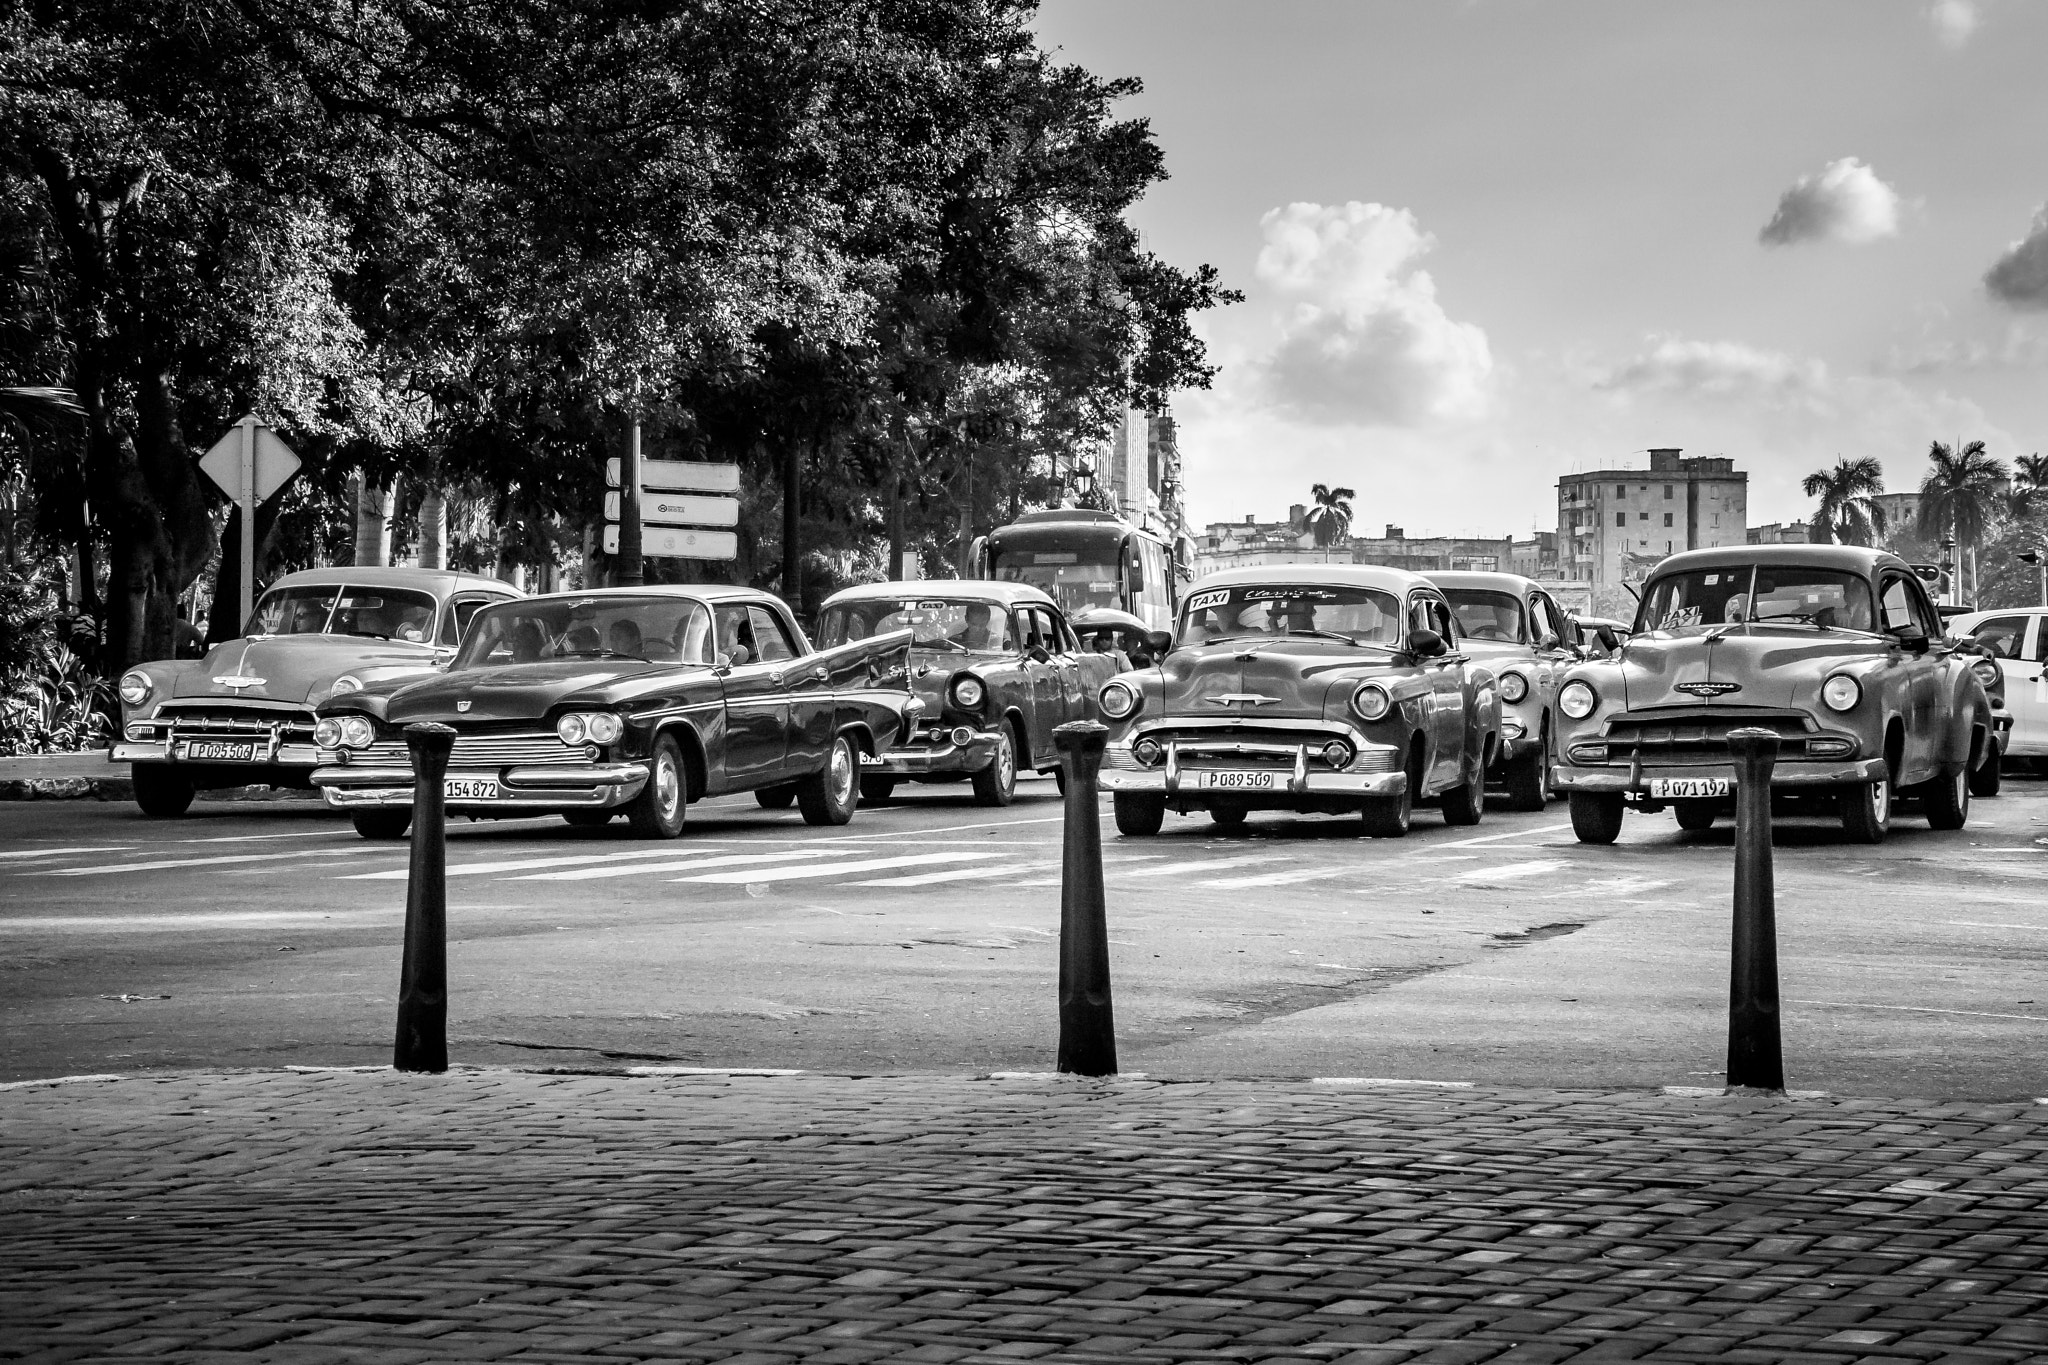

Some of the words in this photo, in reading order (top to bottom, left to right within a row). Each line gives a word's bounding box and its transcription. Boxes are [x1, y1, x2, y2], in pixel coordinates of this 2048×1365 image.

[1193, 593, 1227, 608] TAXI
[1663, 606, 1699, 623] TAXI
[266, 619, 279, 628] TAXI
[446, 782, 470, 797] 154
[472, 782, 496, 797] 872
